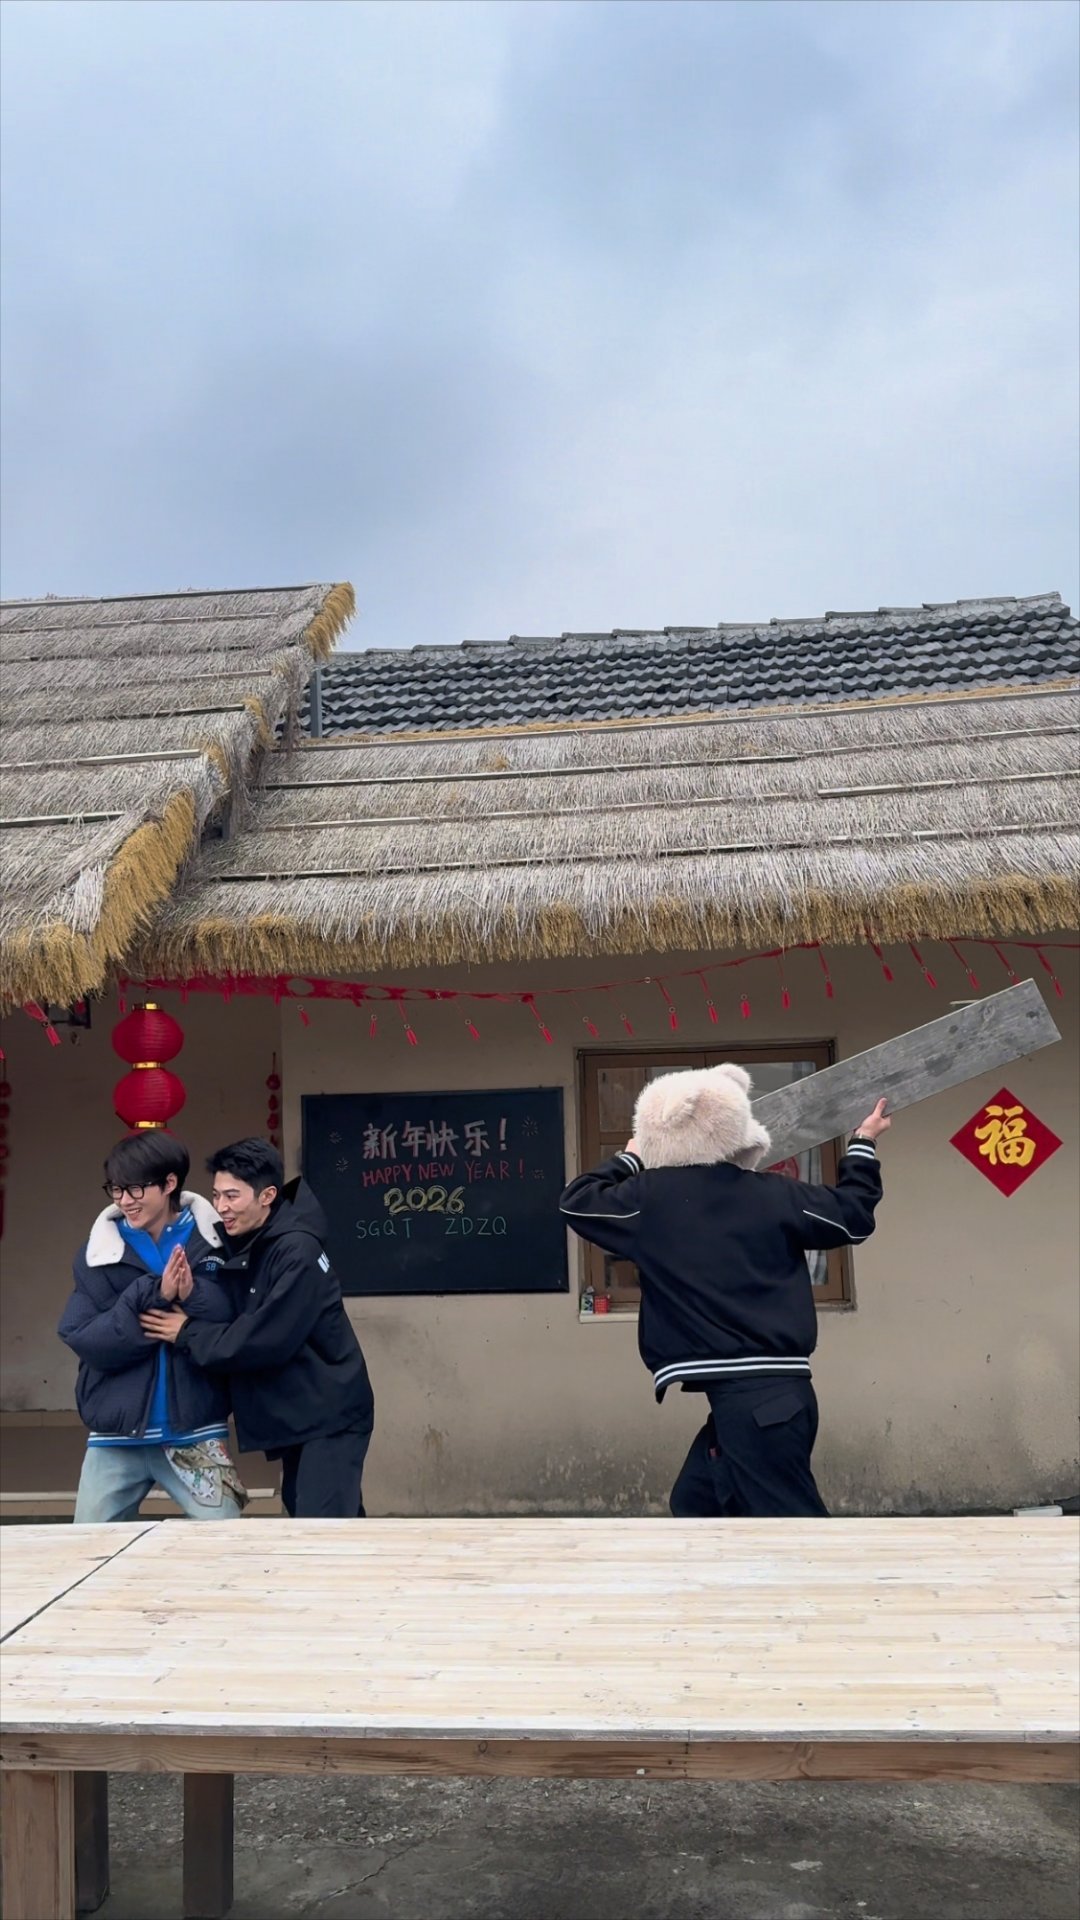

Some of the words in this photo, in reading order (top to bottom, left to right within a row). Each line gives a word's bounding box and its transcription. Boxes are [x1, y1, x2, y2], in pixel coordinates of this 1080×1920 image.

[362, 1117, 507, 1160] 新年快乐!
[974, 1104, 1037, 1167] 福
[361, 1163, 413, 1188] HAPPY
[418, 1161, 455, 1181] NEW
[383, 1184, 466, 1216] 2026
[355, 1217, 414, 1239] SGQT
[444, 1215, 508, 1236] ZDZQ
